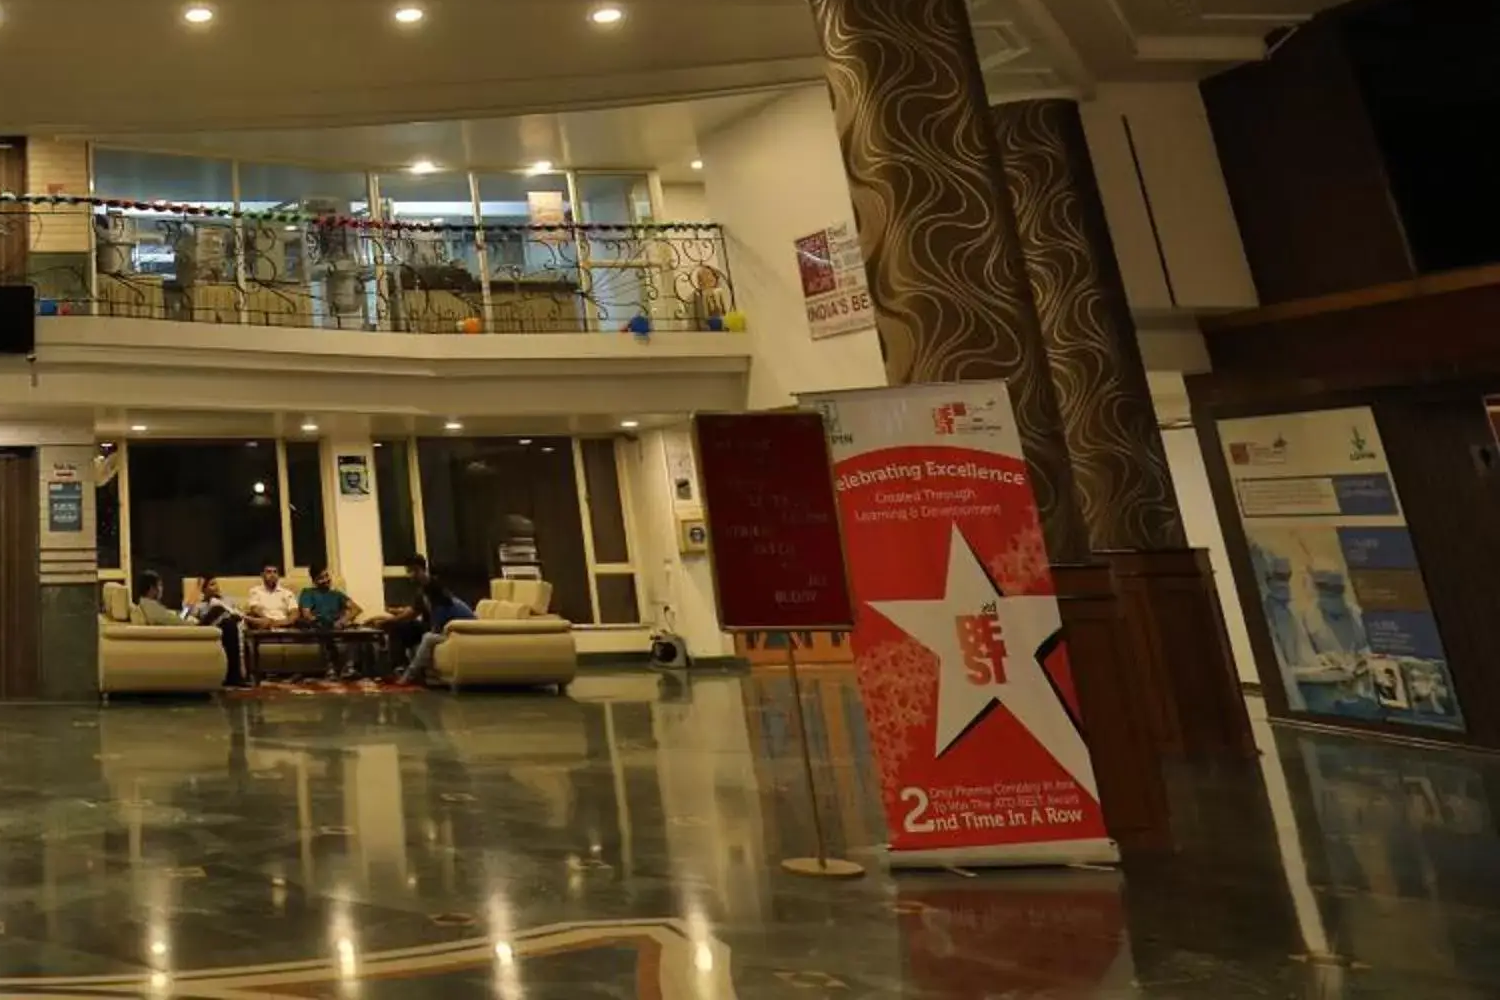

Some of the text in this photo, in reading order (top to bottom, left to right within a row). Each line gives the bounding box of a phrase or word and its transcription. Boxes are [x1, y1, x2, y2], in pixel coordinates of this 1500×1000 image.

[836, 461, 1025, 491] elebrating Excellence
[855, 507, 908, 522] Learning
[921, 503, 1002, 519] Development
[962, 811, 1005, 830] Time
[1008, 809, 1027, 826] In
[1030, 808, 1043, 824] A
[1046, 806, 1084, 824] Row
